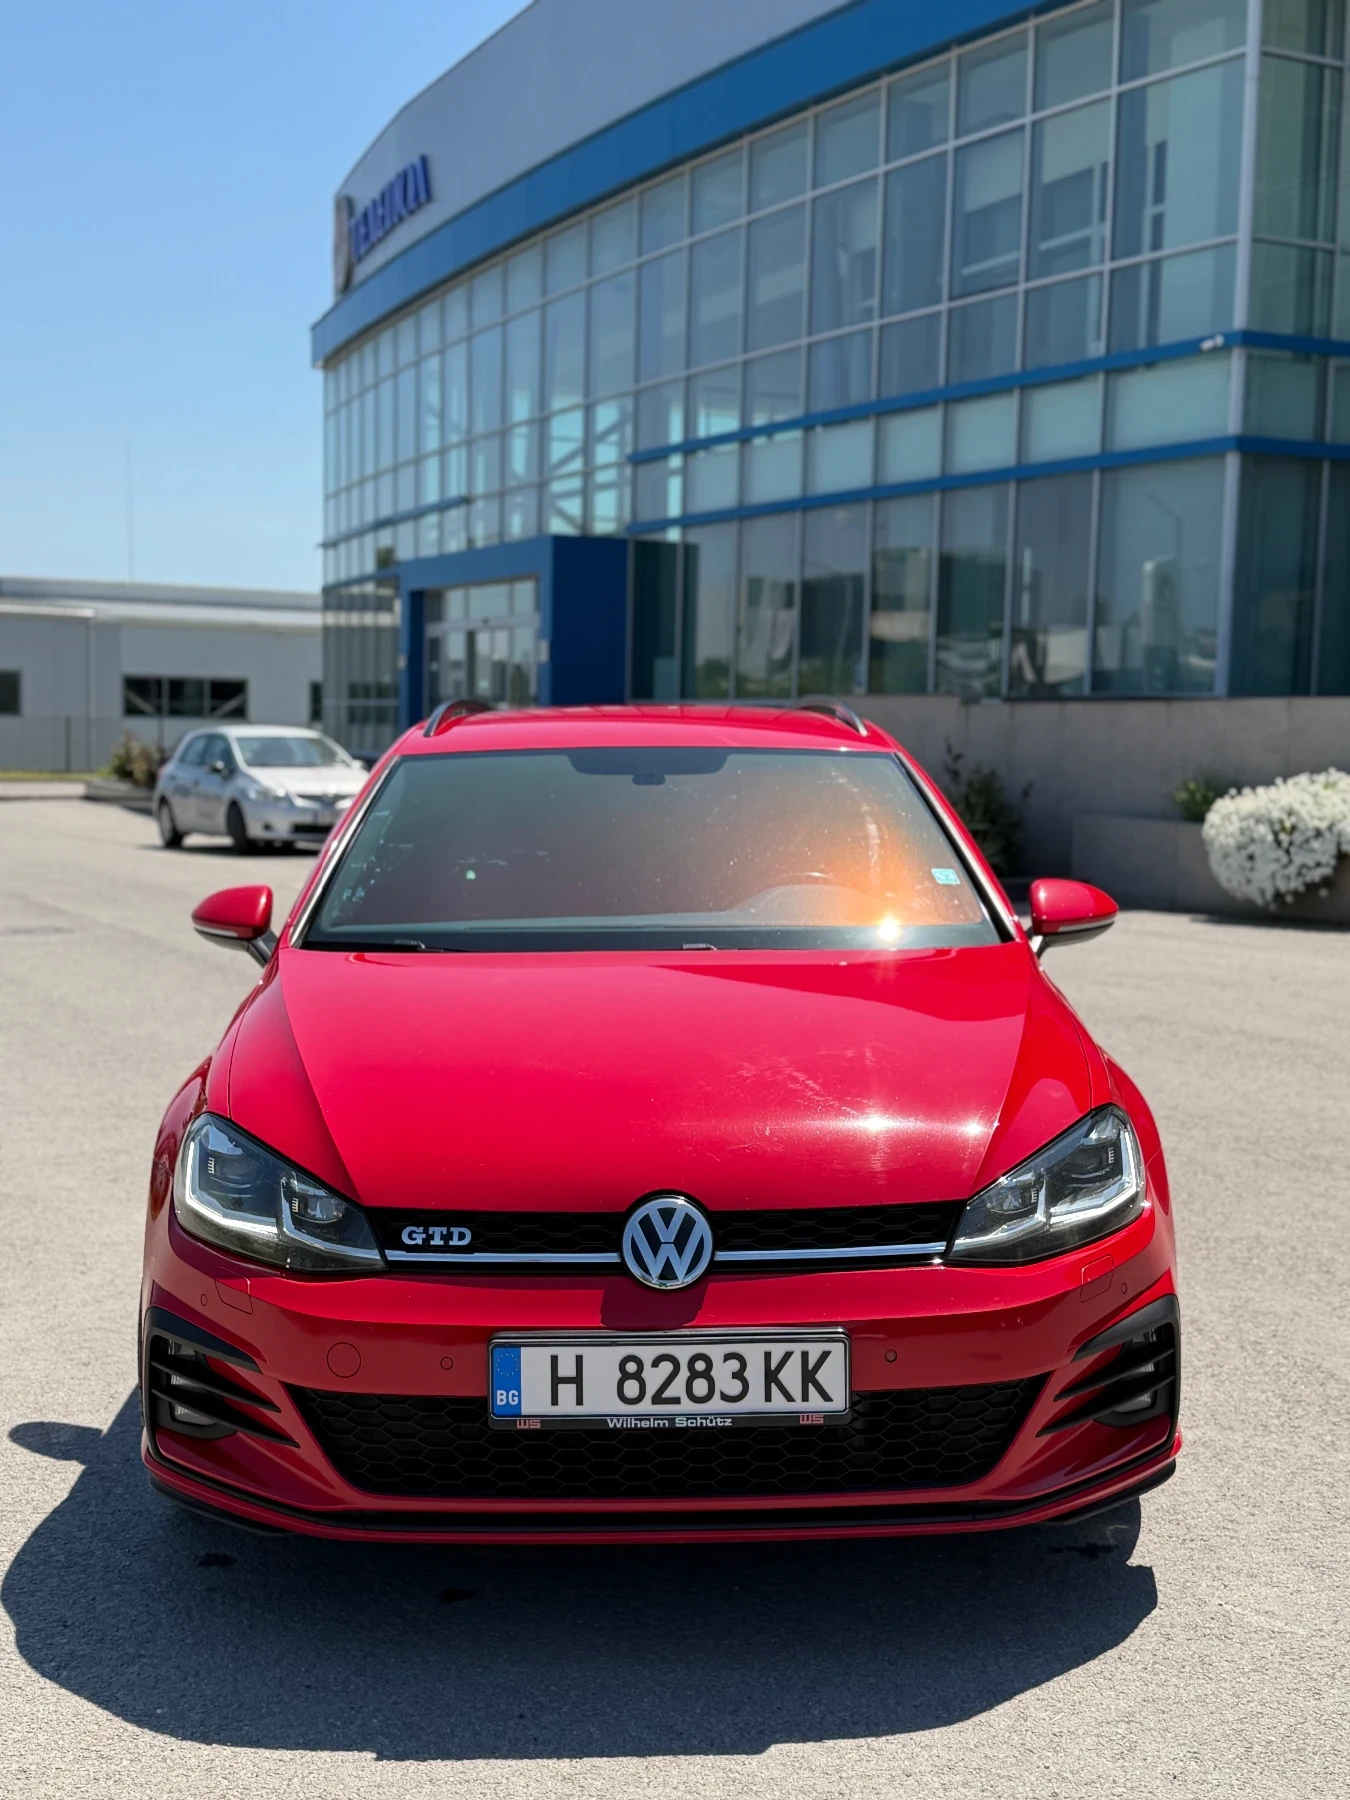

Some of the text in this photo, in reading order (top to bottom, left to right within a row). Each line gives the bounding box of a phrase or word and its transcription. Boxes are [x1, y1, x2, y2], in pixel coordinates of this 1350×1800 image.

[401, 1226, 472, 1246] GTD
[550, 1350, 835, 1406] H 8283 KK
[496, 1389, 519, 1406] BG
[516, 1418, 541, 1429] WS
[607, 1416, 732, 1428] Wilhelm Schütz
[800, 1413, 824, 1424] WS
